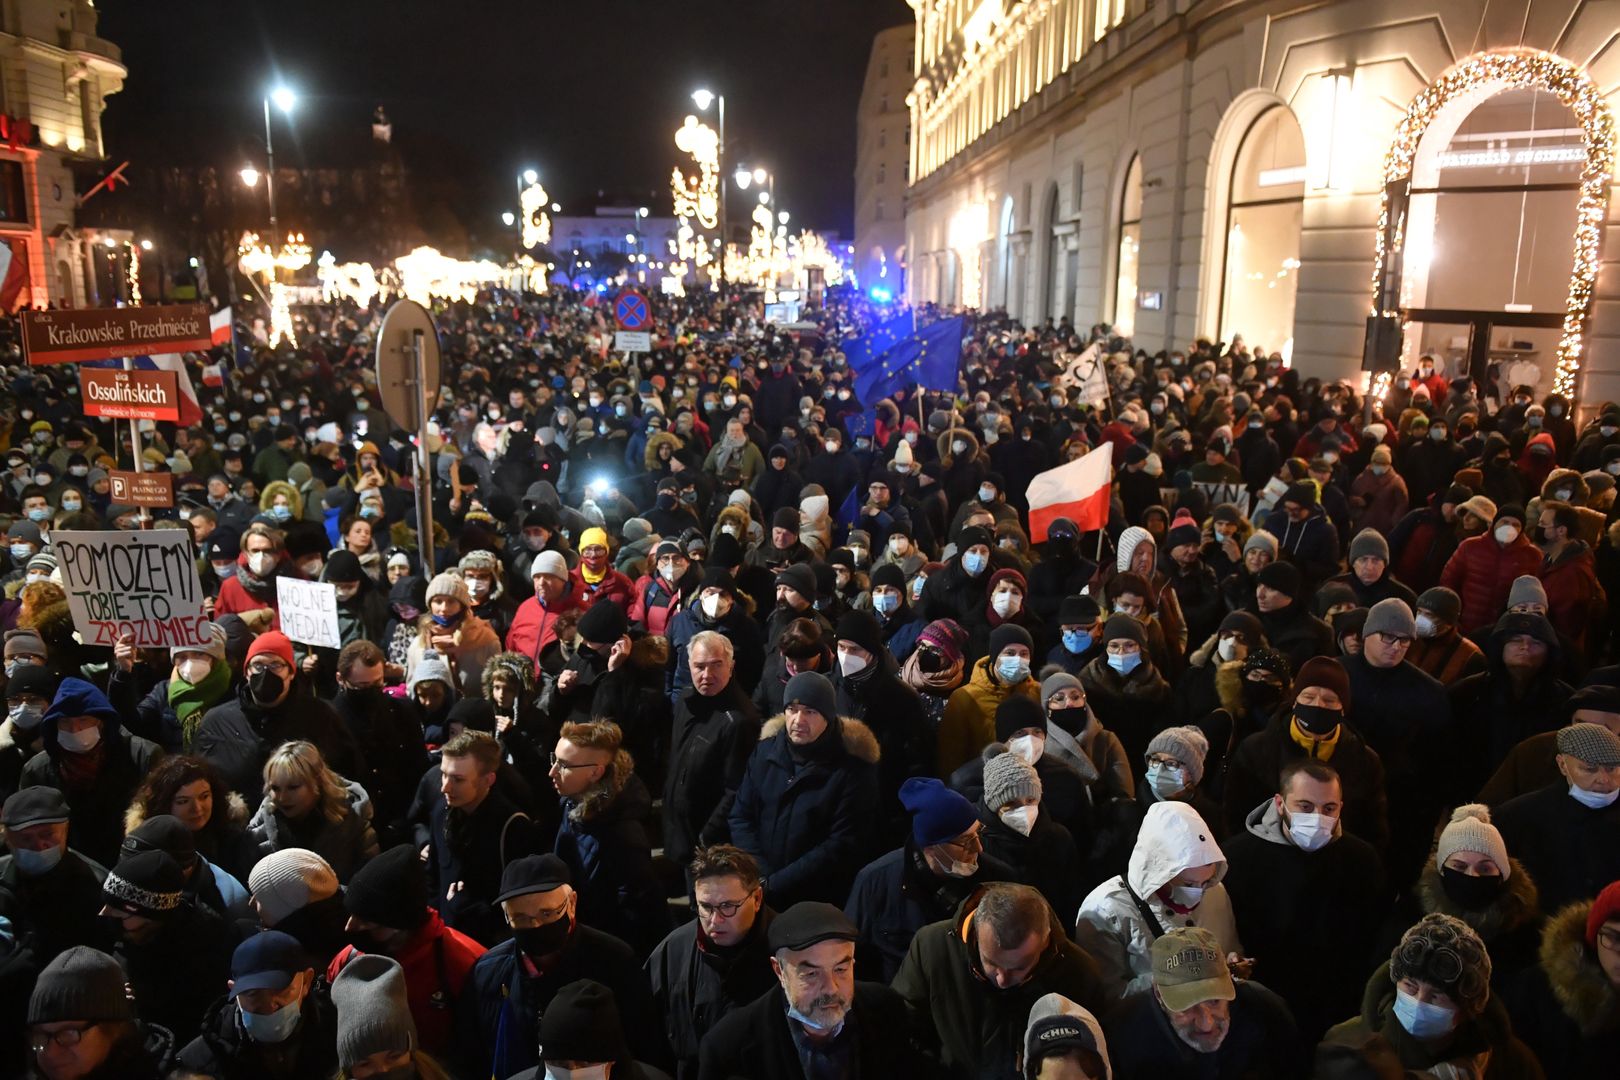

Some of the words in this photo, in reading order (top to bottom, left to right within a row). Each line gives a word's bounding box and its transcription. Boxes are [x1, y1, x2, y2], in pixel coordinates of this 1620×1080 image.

[48, 321, 125, 345] Krakowskie
[130, 317, 200, 339] Przedmieście
[115, 372, 129, 382] ulica
[88, 381, 167, 404] Ossolińskich
[57, 537, 193, 602] POMOŻEMY
[72, 591, 130, 621] TOBIE
[129, 594, 171, 621] TO
[278, 585, 332, 613] WOLNE
[89, 605, 212, 647] ZROZUMIEĆ
[282, 611, 333, 643] MEDIA
[1166, 949, 1203, 970] ROUTE
[1040, 1027, 1080, 1040] CHILD
